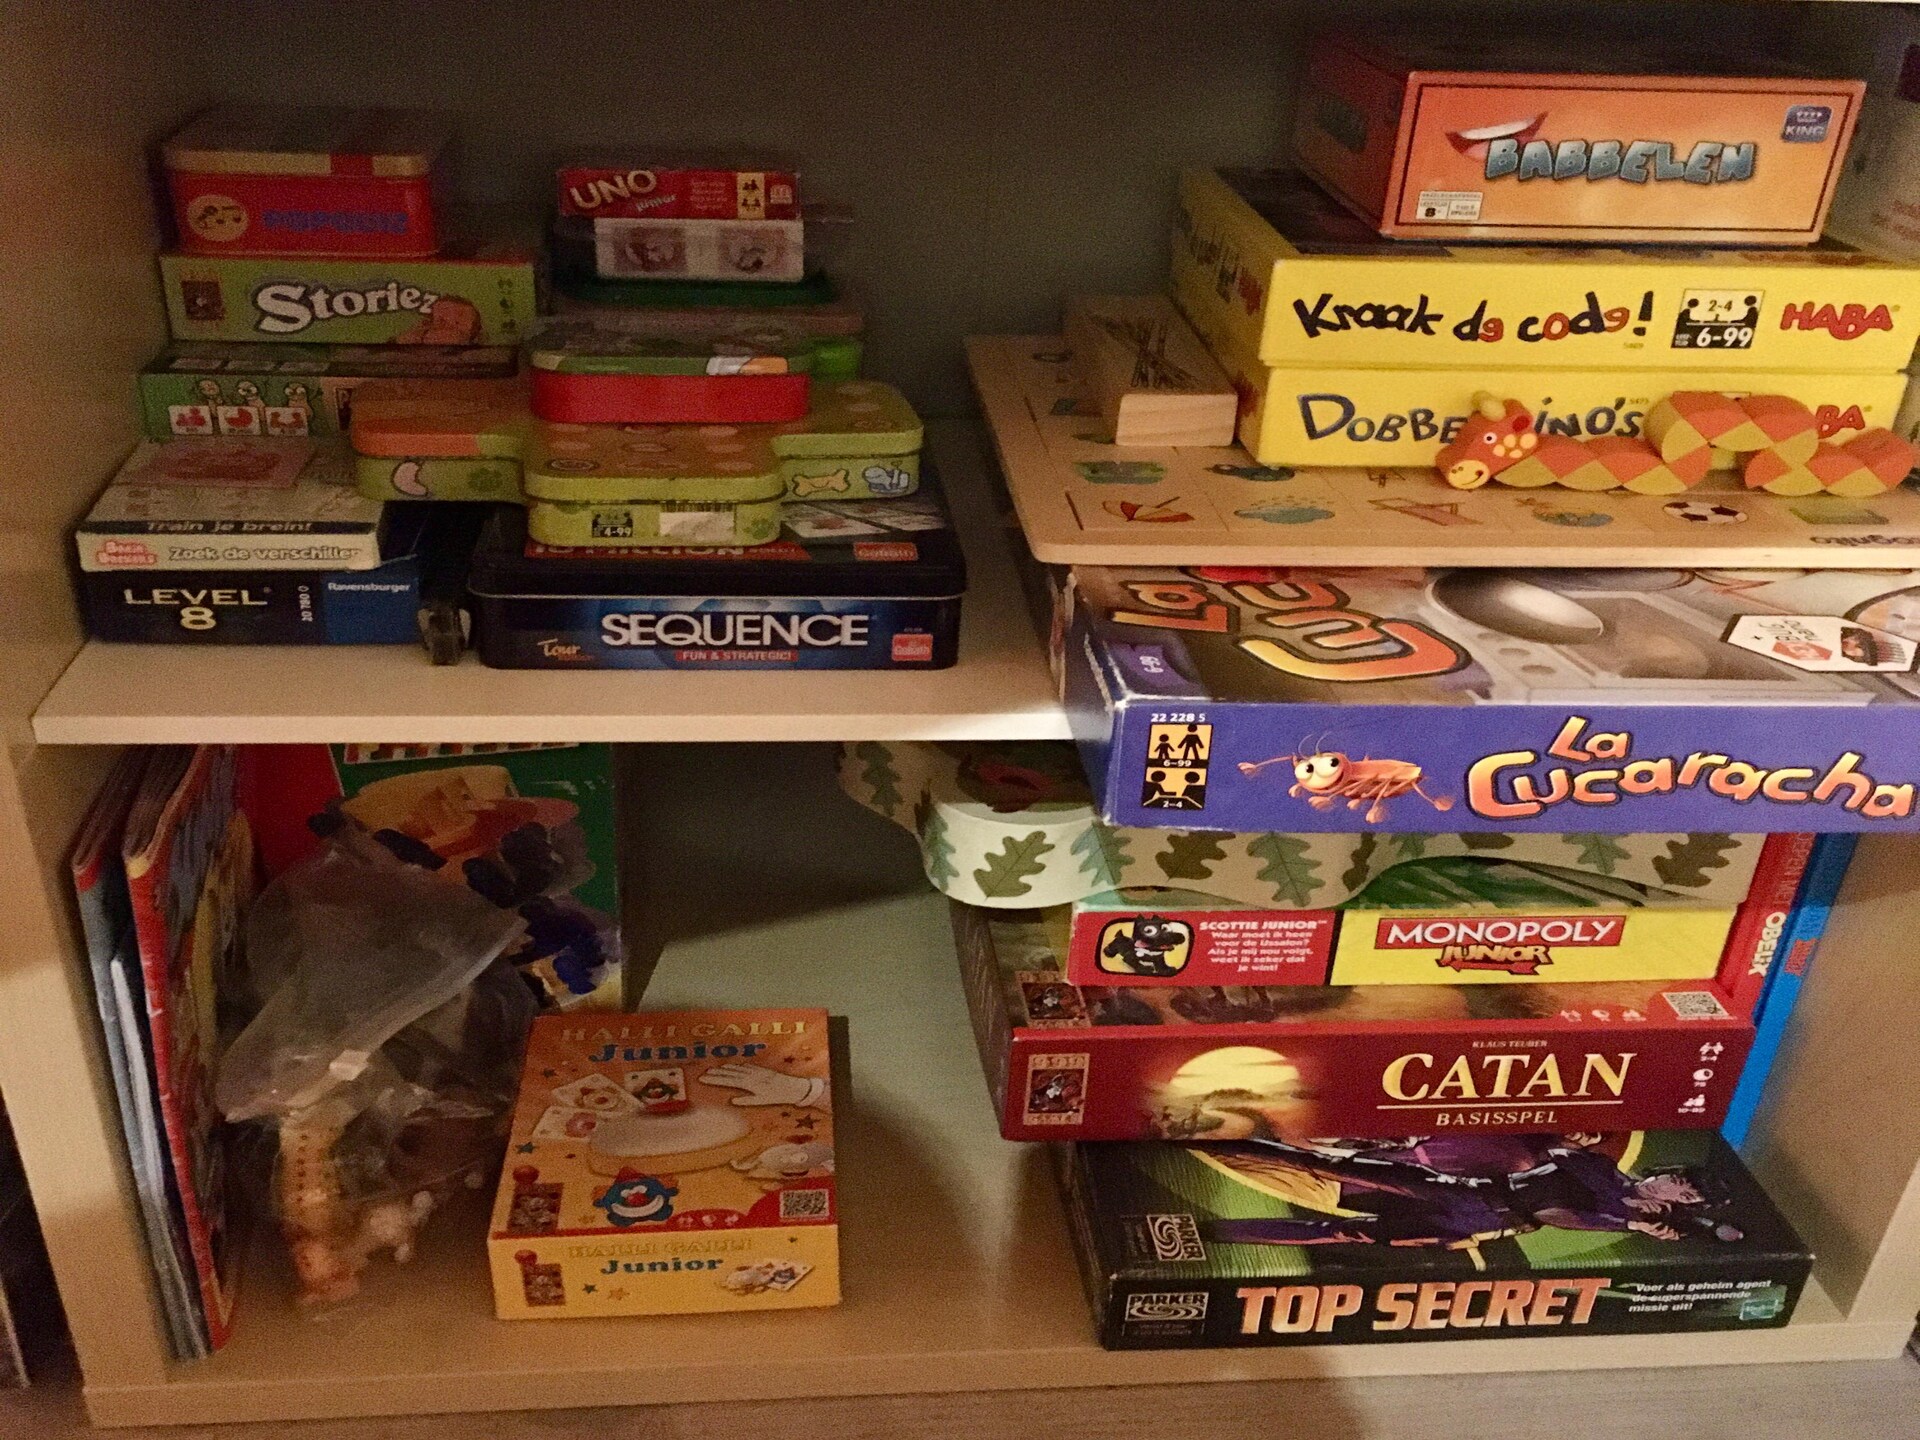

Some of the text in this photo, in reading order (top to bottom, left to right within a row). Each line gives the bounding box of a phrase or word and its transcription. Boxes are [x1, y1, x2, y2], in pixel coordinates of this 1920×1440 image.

[1784, 125, 1826, 136] KING
[1484, 138, 1756, 184] BABBELEN
[570, 169, 658, 209] UNO
[256, 282, 437, 333] Storiez
[1294, 290, 1655, 343] Kraak de code!
[1708, 300, 1733, 312] 2-4
[1780, 301, 1893, 341] HABA
[1696, 327, 1753, 348] 6-99
[1297, 393, 1468, 444] DOBBE
[1816, 405, 1864, 435] BA
[604, 526, 632, 537] 4-99
[169, 547, 218, 561] Zoek
[223, 546, 250, 561] de
[124, 588, 268, 606] LEVEL
[328, 581, 411, 594] Ravensburger
[180, 606, 216, 630] 8
[601, 612, 869, 647] SEQUENCE
[682, 650, 709, 661] FUN
[712, 650, 721, 661] &
[1150, 713, 1206, 722] 22 228 5
[1548, 716, 1630, 763] La
[1468, 749, 1916, 820] Cucaracha
[1199, 922, 1258, 930] SCOTTIE
[1387, 921, 1617, 944] MONOPOLY
[1441, 944, 1551, 963] JUNIOR
[561, 1021, 808, 1042] HALLI GALLI
[589, 1043, 767, 1062] Junior
[1381, 1053, 1638, 1101] CATAN
[1435, 1111, 1558, 1127] BASISSPEL
[601, 1257, 724, 1275] Junior
[1636, 1280, 1772, 1292] Voer als geheim agent
[1237, 1277, 1611, 1334] TOP SECRET
[1629, 1303, 1693, 1312] missie uit!
